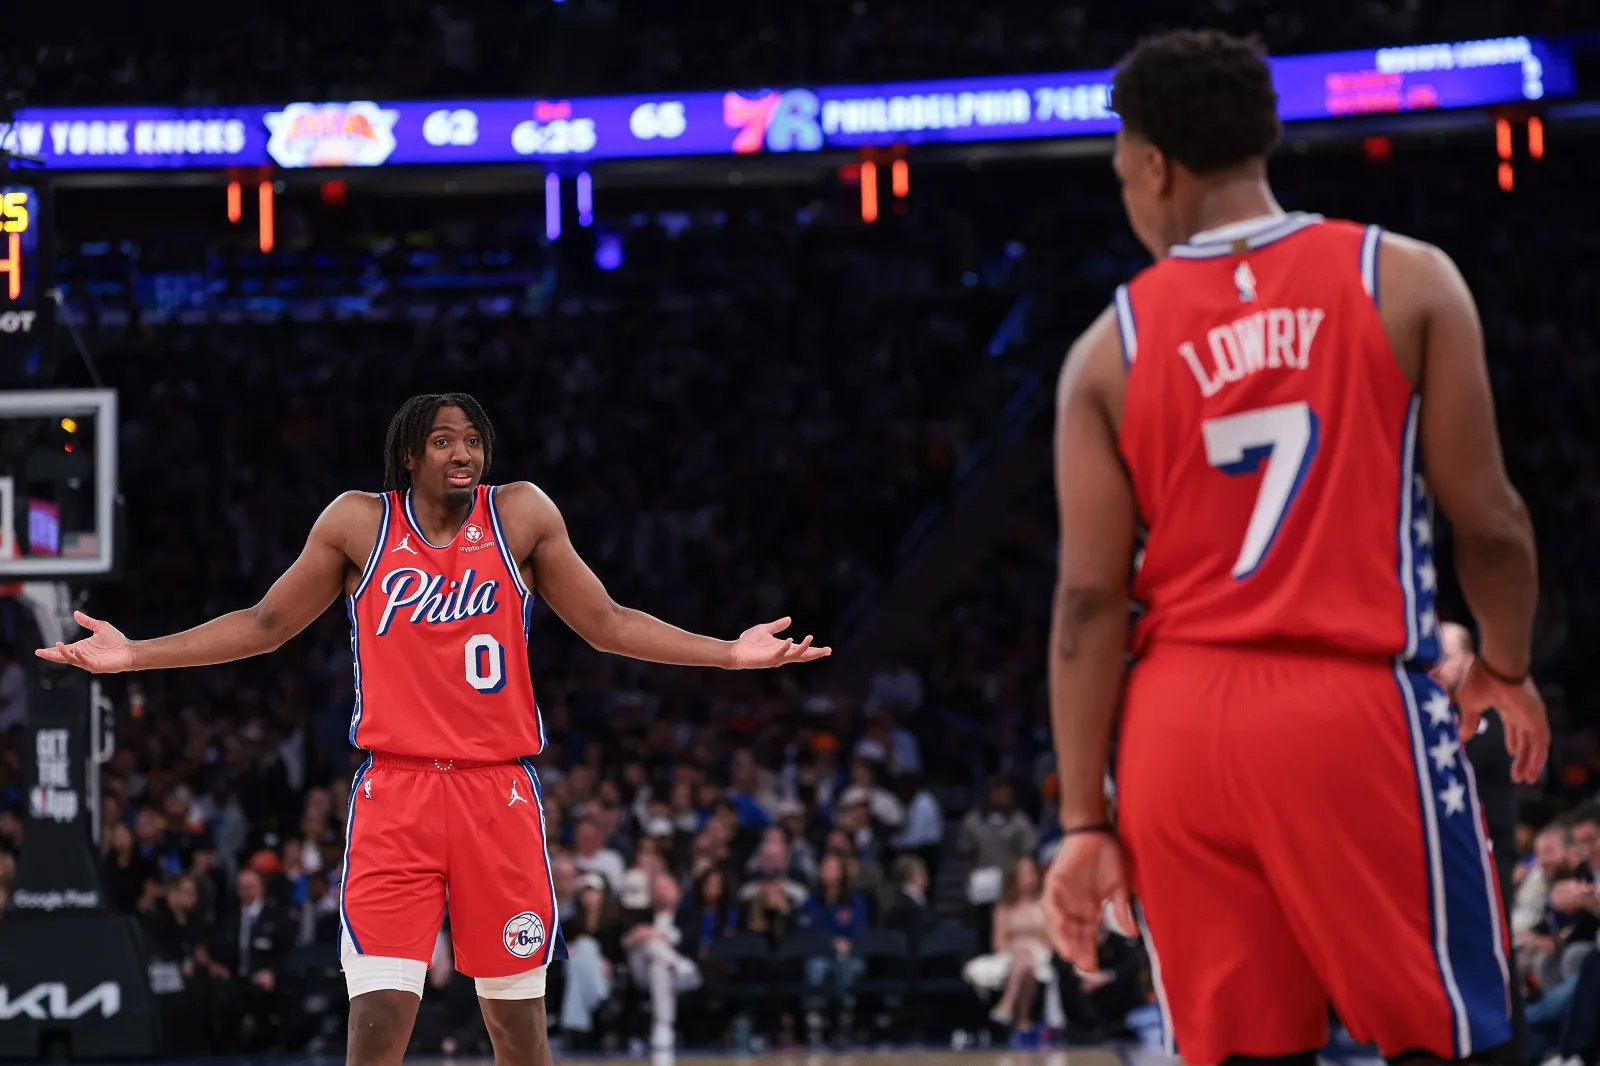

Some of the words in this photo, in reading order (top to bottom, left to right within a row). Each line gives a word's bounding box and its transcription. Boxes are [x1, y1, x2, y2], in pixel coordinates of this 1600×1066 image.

[50, 121, 128, 155] YORK
[134, 119, 246, 154] KNICKS
[422, 108, 479, 146] 62
[629, 101, 687, 139] 65
[1178, 308, 1325, 397] LOWRY
[1202, 401, 1321, 582] 7
[459, 541, 496, 553] crypto.com
[375, 567, 500, 637] Phila
[464, 633, 507, 694] 0
[508, 929, 542, 947] 76ers
